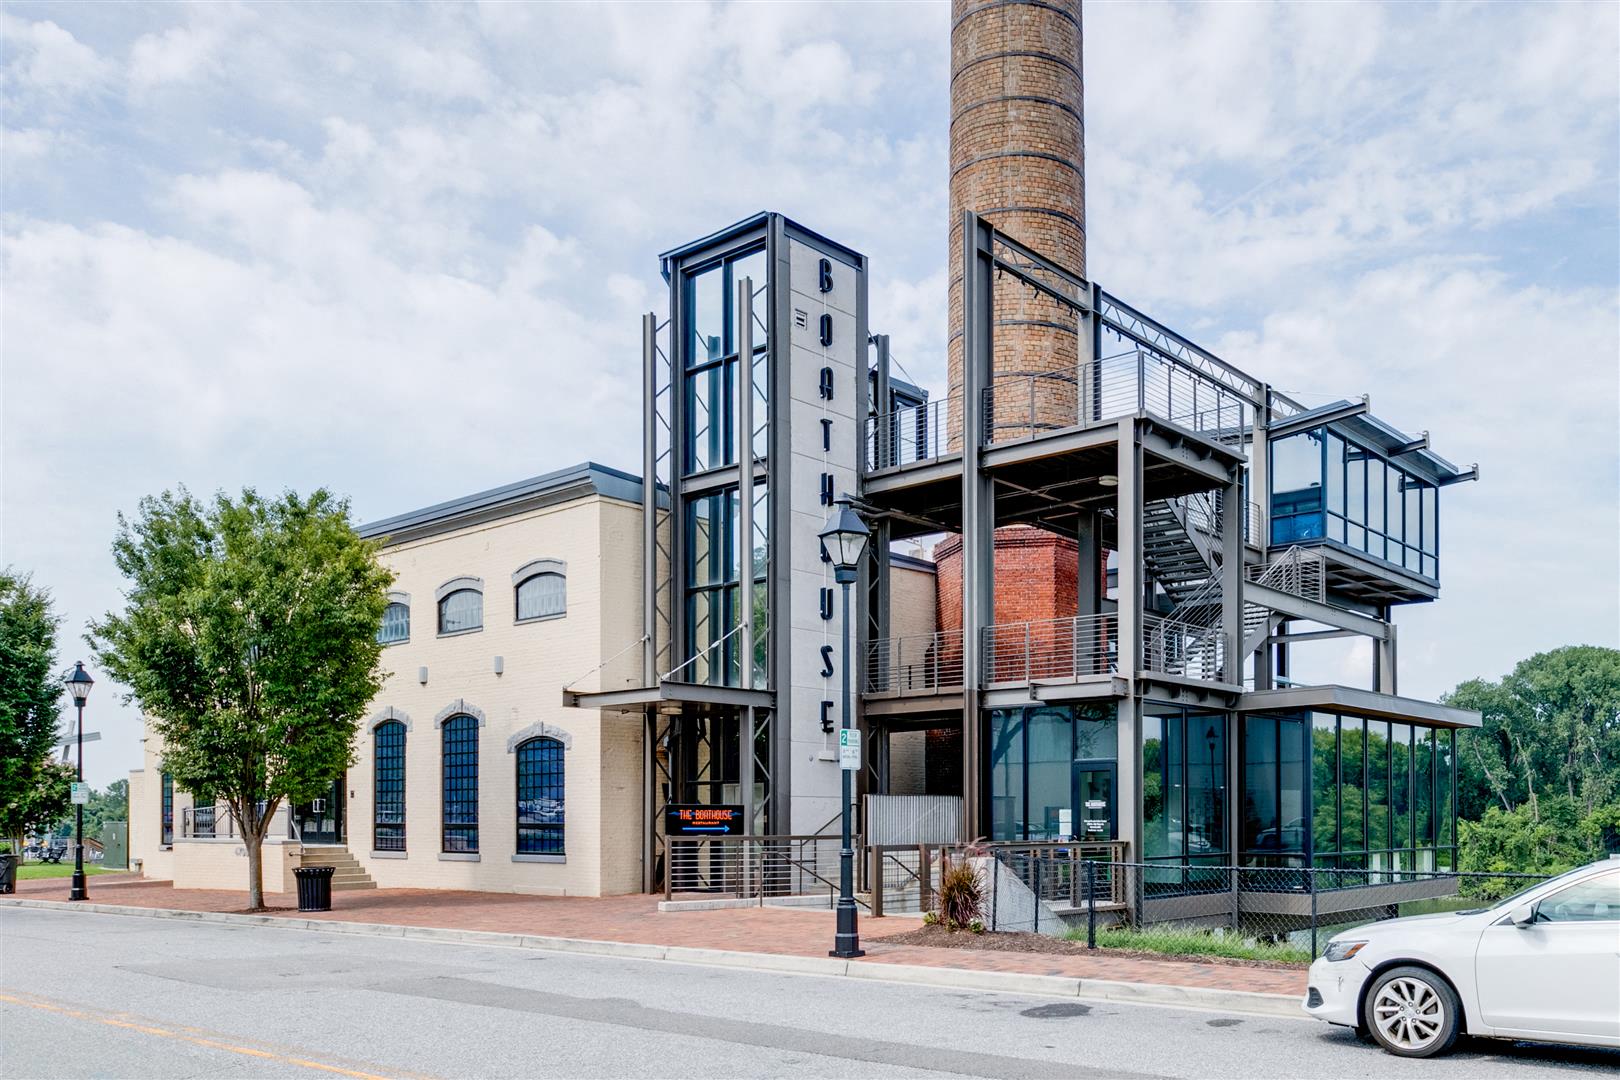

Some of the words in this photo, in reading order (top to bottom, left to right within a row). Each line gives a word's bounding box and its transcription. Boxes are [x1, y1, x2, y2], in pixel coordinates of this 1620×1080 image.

[841, 733, 847, 744] 2
[679, 809, 692, 820] THE
[695, 809, 732, 820] BOATHOUSE
